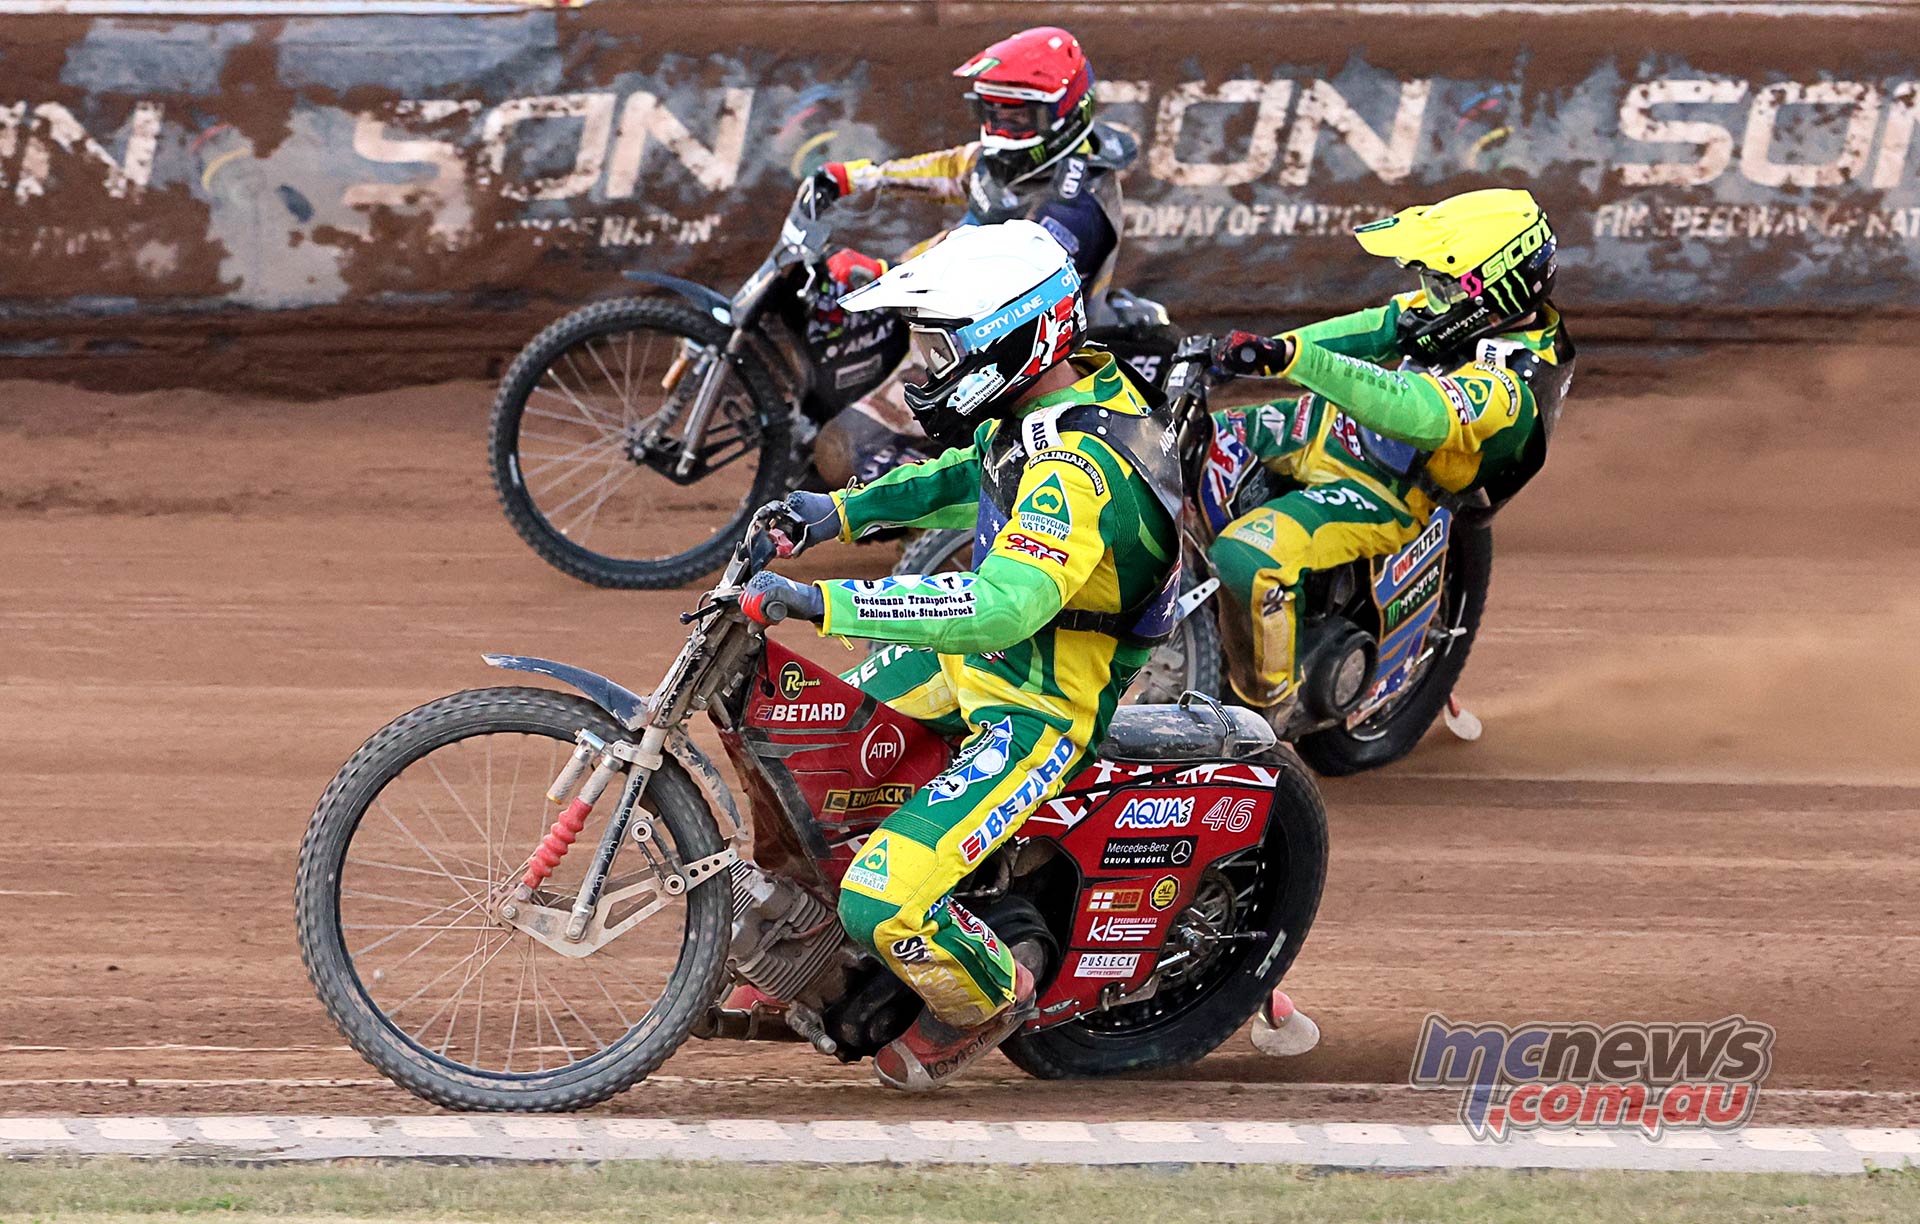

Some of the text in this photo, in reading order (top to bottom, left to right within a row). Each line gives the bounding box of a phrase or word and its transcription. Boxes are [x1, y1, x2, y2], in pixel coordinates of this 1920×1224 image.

[1227, 204, 1271, 237] OF
[1031, 421, 1049, 451] AUS
[770, 702, 846, 722] BETARD
[867, 742, 897, 759] ATPI
[985, 737, 1075, 841] BETARD
[1118, 801, 1180, 825] AQUA
[1202, 796, 1257, 832] 46
[1107, 842, 1170, 853] Mercedes-Benz
